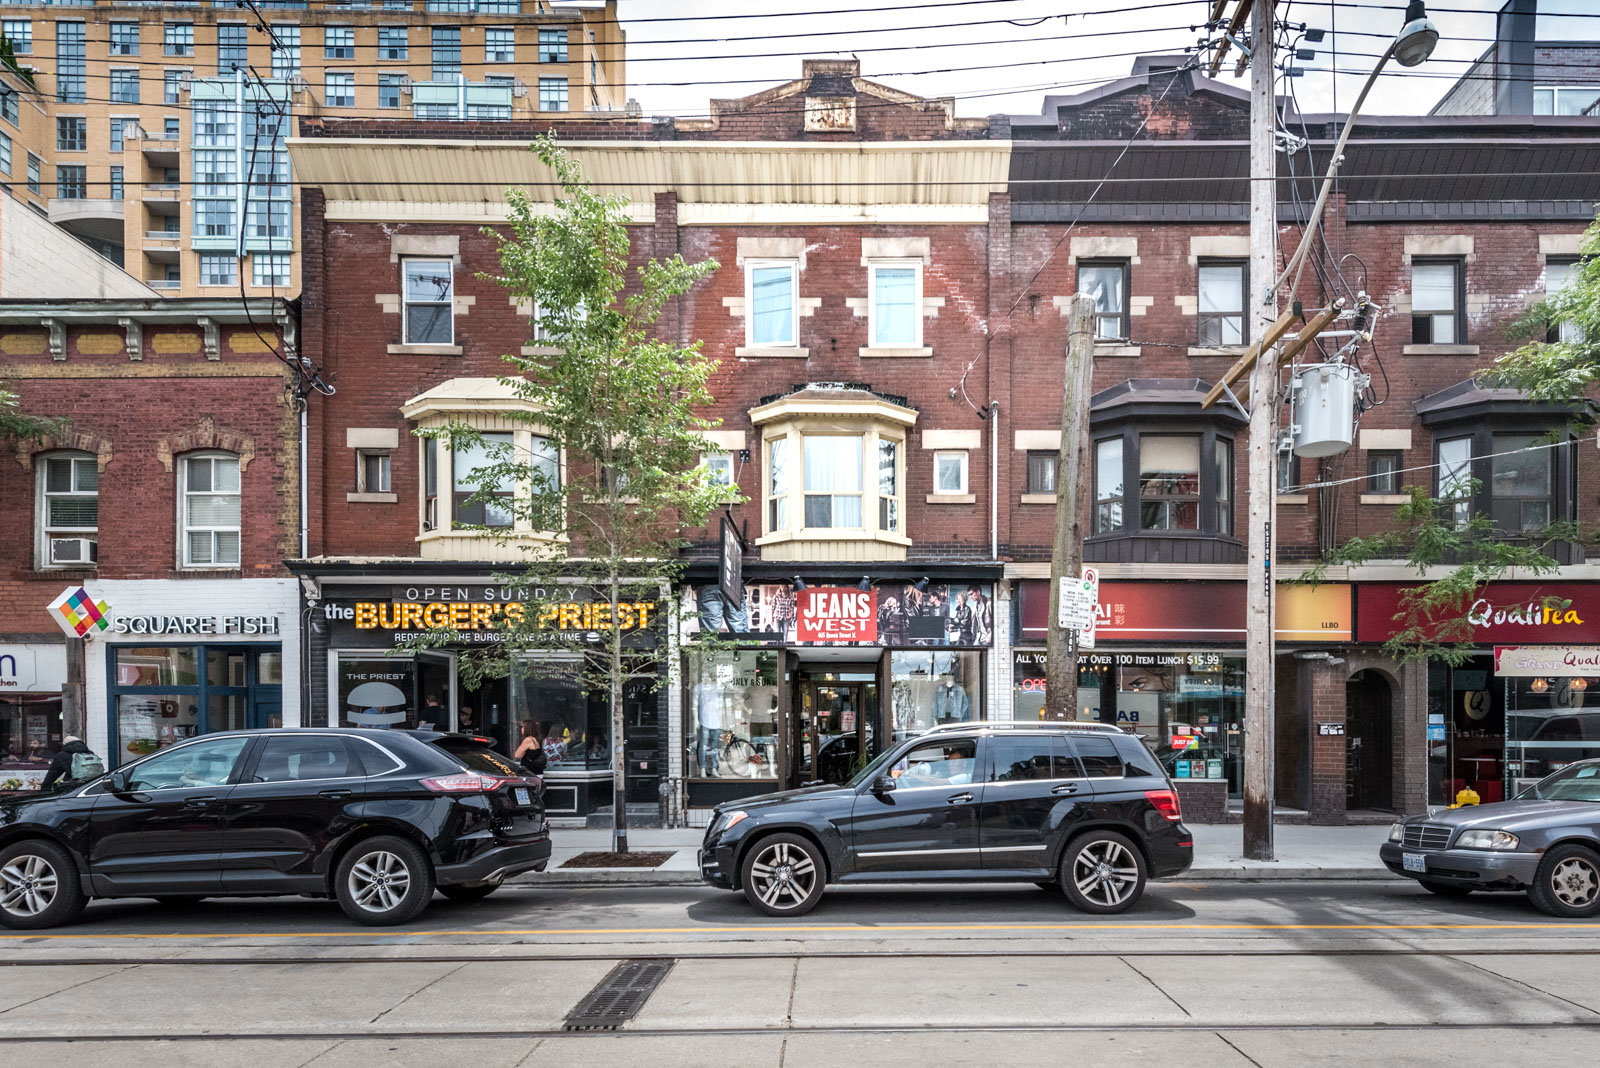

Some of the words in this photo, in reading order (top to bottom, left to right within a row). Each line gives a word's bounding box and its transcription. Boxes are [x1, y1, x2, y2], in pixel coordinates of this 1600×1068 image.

[406, 587, 469, 600] OPEN
[484, 587, 578, 600] SUNDAY
[803, 593, 871, 619] JEANS
[1094, 603, 1111, 618] AI
[324, 603, 355, 620] the
[355, 602, 525, 629] BURGER'S
[538, 602, 655, 630] PRIEST
[113, 616, 215, 634] SQUARE
[223, 616, 278, 634] FISH
[803, 618, 871, 631] WEST
[452, 632, 471, 642] HE
[559, 632, 581, 642] TIME
[1015, 653, 1032, 664] ALL
[1077, 655, 1088, 664] AT
[1090, 654, 1112, 664] OVER
[1115, 654, 1133, 664] 100
[1136, 655, 1154, 664] ITEM
[1157, 655, 1184, 664] LUNCH
[1187, 655, 1219, 665] $15.99
[1563, 652, 1600, 666] Qual
[0, 678, 18, 687] hen
[1022, 678, 1047, 691] OPE
